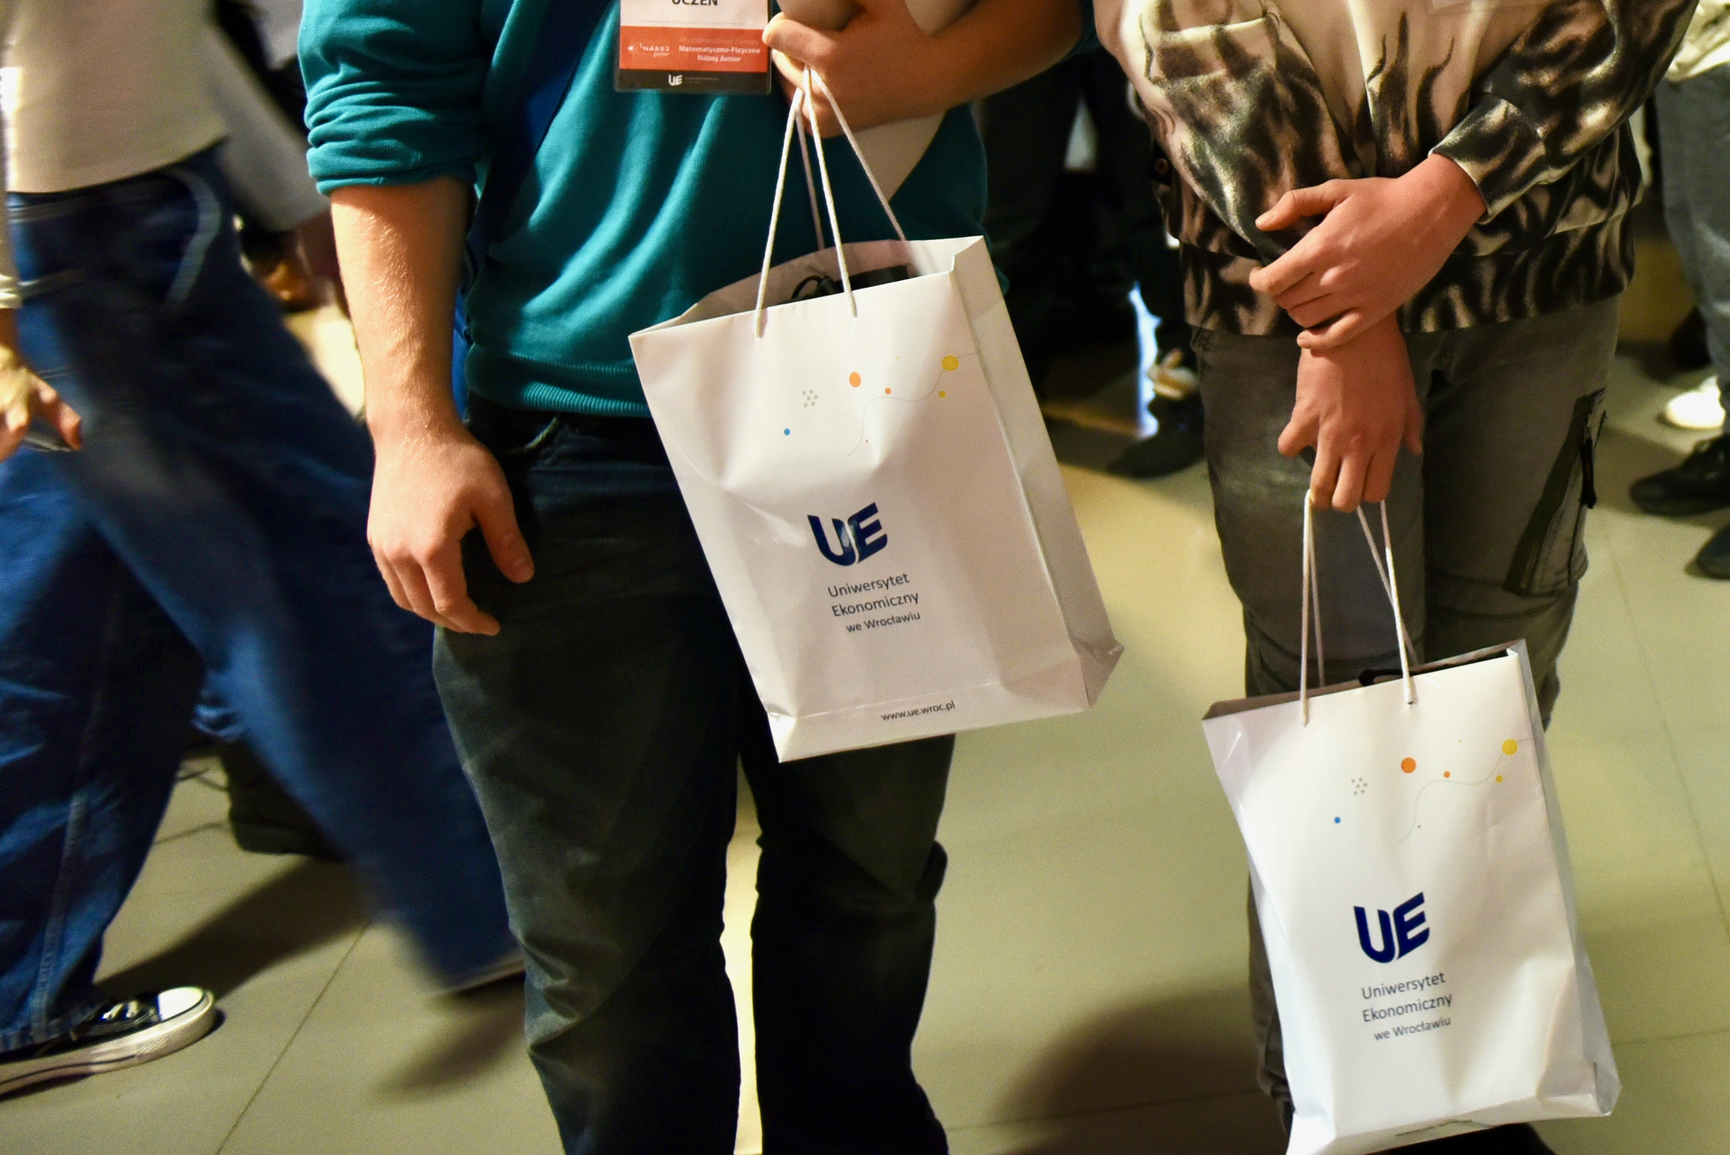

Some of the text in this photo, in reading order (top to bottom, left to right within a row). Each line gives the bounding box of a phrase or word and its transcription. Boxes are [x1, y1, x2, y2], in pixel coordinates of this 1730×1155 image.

[808, 502, 888, 566] UE
[827, 571, 910, 599] Uniwersytet
[831, 590, 919, 619] Ekonomiczny
[846, 610, 921, 633] we Wrocławiu
[880, 700, 956, 721] www.ue.wroc.pl
[1353, 891, 1431, 964] UE
[1360, 971, 1446, 1001] Uniwersytet
[1362, 992, 1453, 1024] Ekonomiczny
[1374, 1016, 1451, 1042] we Wrocławiu
